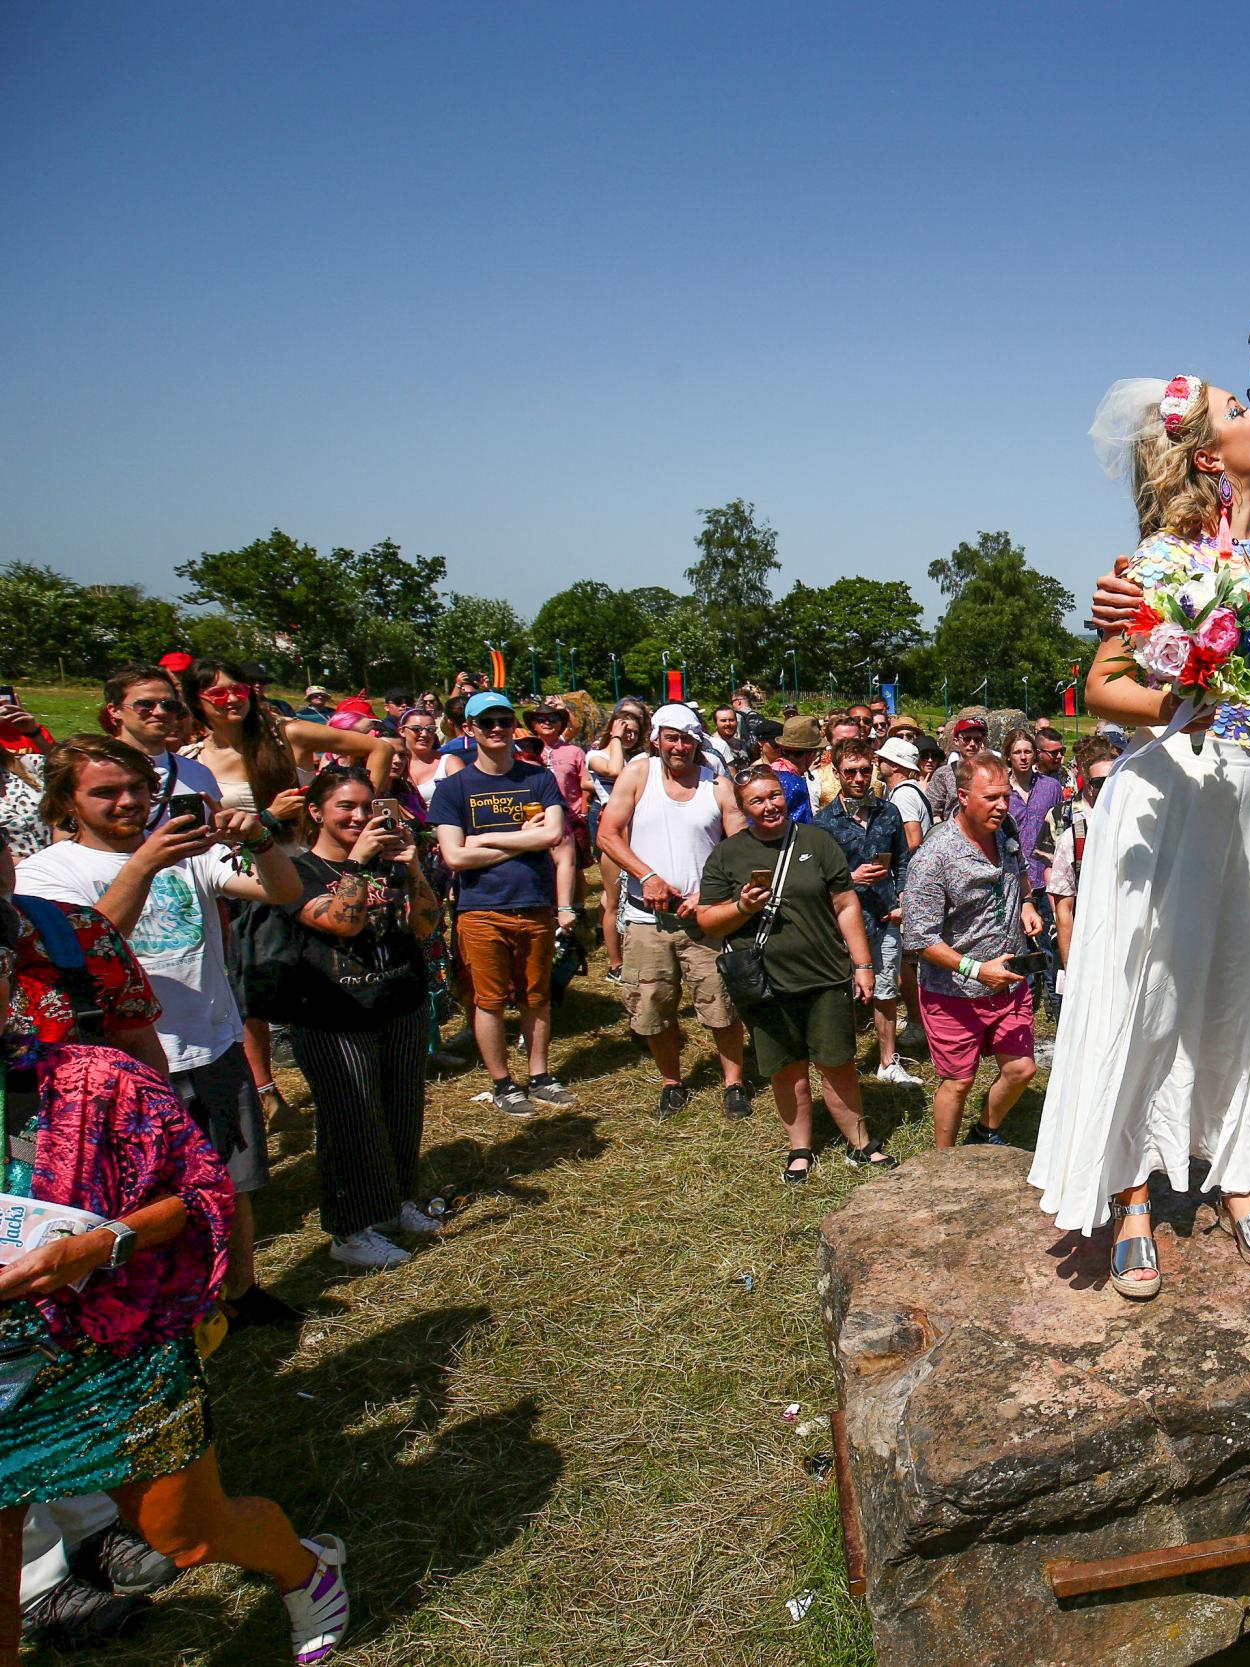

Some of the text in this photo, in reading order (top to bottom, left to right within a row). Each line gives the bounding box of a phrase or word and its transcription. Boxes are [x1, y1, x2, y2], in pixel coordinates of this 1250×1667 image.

[469, 795, 513, 807] Bombay
[492, 802, 523, 815] Bicycl
[0, 1206, 25, 1248] Jack's
